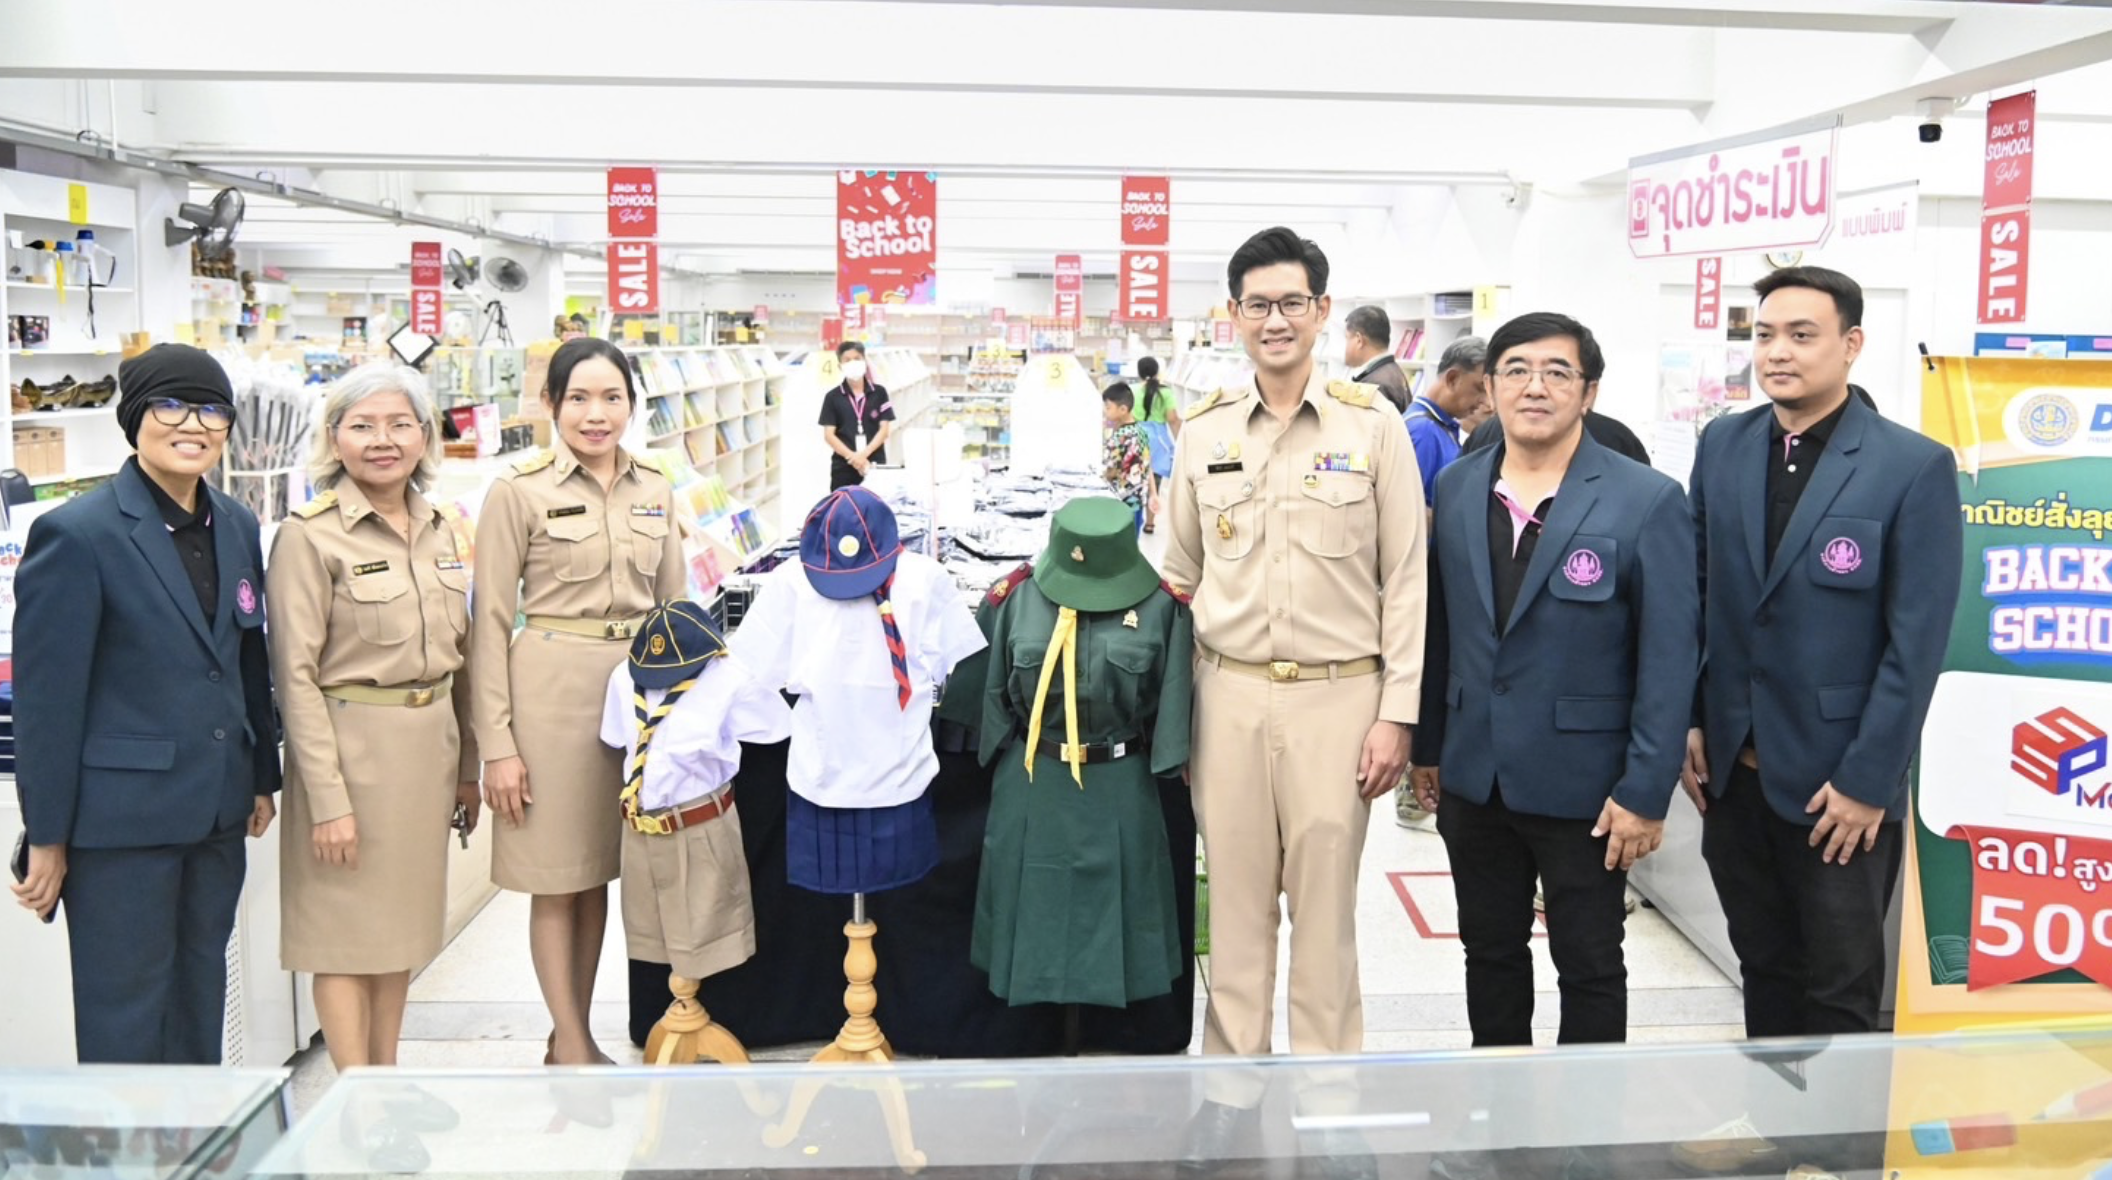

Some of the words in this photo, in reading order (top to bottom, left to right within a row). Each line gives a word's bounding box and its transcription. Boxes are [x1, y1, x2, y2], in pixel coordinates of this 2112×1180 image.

[1991, 123, 2014, 139] BACK
[2018, 119, 2029, 133] TO
[1986, 136, 2032, 161] SCHOOL
[609, 195, 656, 206] SCHOOL
[613, 183, 637, 193] BACK
[641, 183, 652, 193] TO
[1126, 191, 1151, 201] BACK
[1154, 192, 1165, 202] TO
[1652, 146, 1828, 252] จุดชำระเงิน
[1122, 203, 1169, 215] SCHOOL
[840, 215, 901, 240] Back
[905, 214, 933, 234] to
[845, 232, 931, 259] School
[618, 244, 649, 308] SALE
[1986, 219, 2019, 319] SALE
[1129, 255, 1159, 318] SALE
[1699, 259, 1717, 326] SALE
[417, 292, 436, 333] SALE
[822, 359, 834, 376] 4
[1050, 362, 1062, 379] 3
[1961, 492, 2112, 539] าณิชย์สั่งลุ
[1985, 547, 2112, 594] BACK
[1992, 606, 2112, 652] SCHO
[1978, 836, 2066, 878] ลด!
